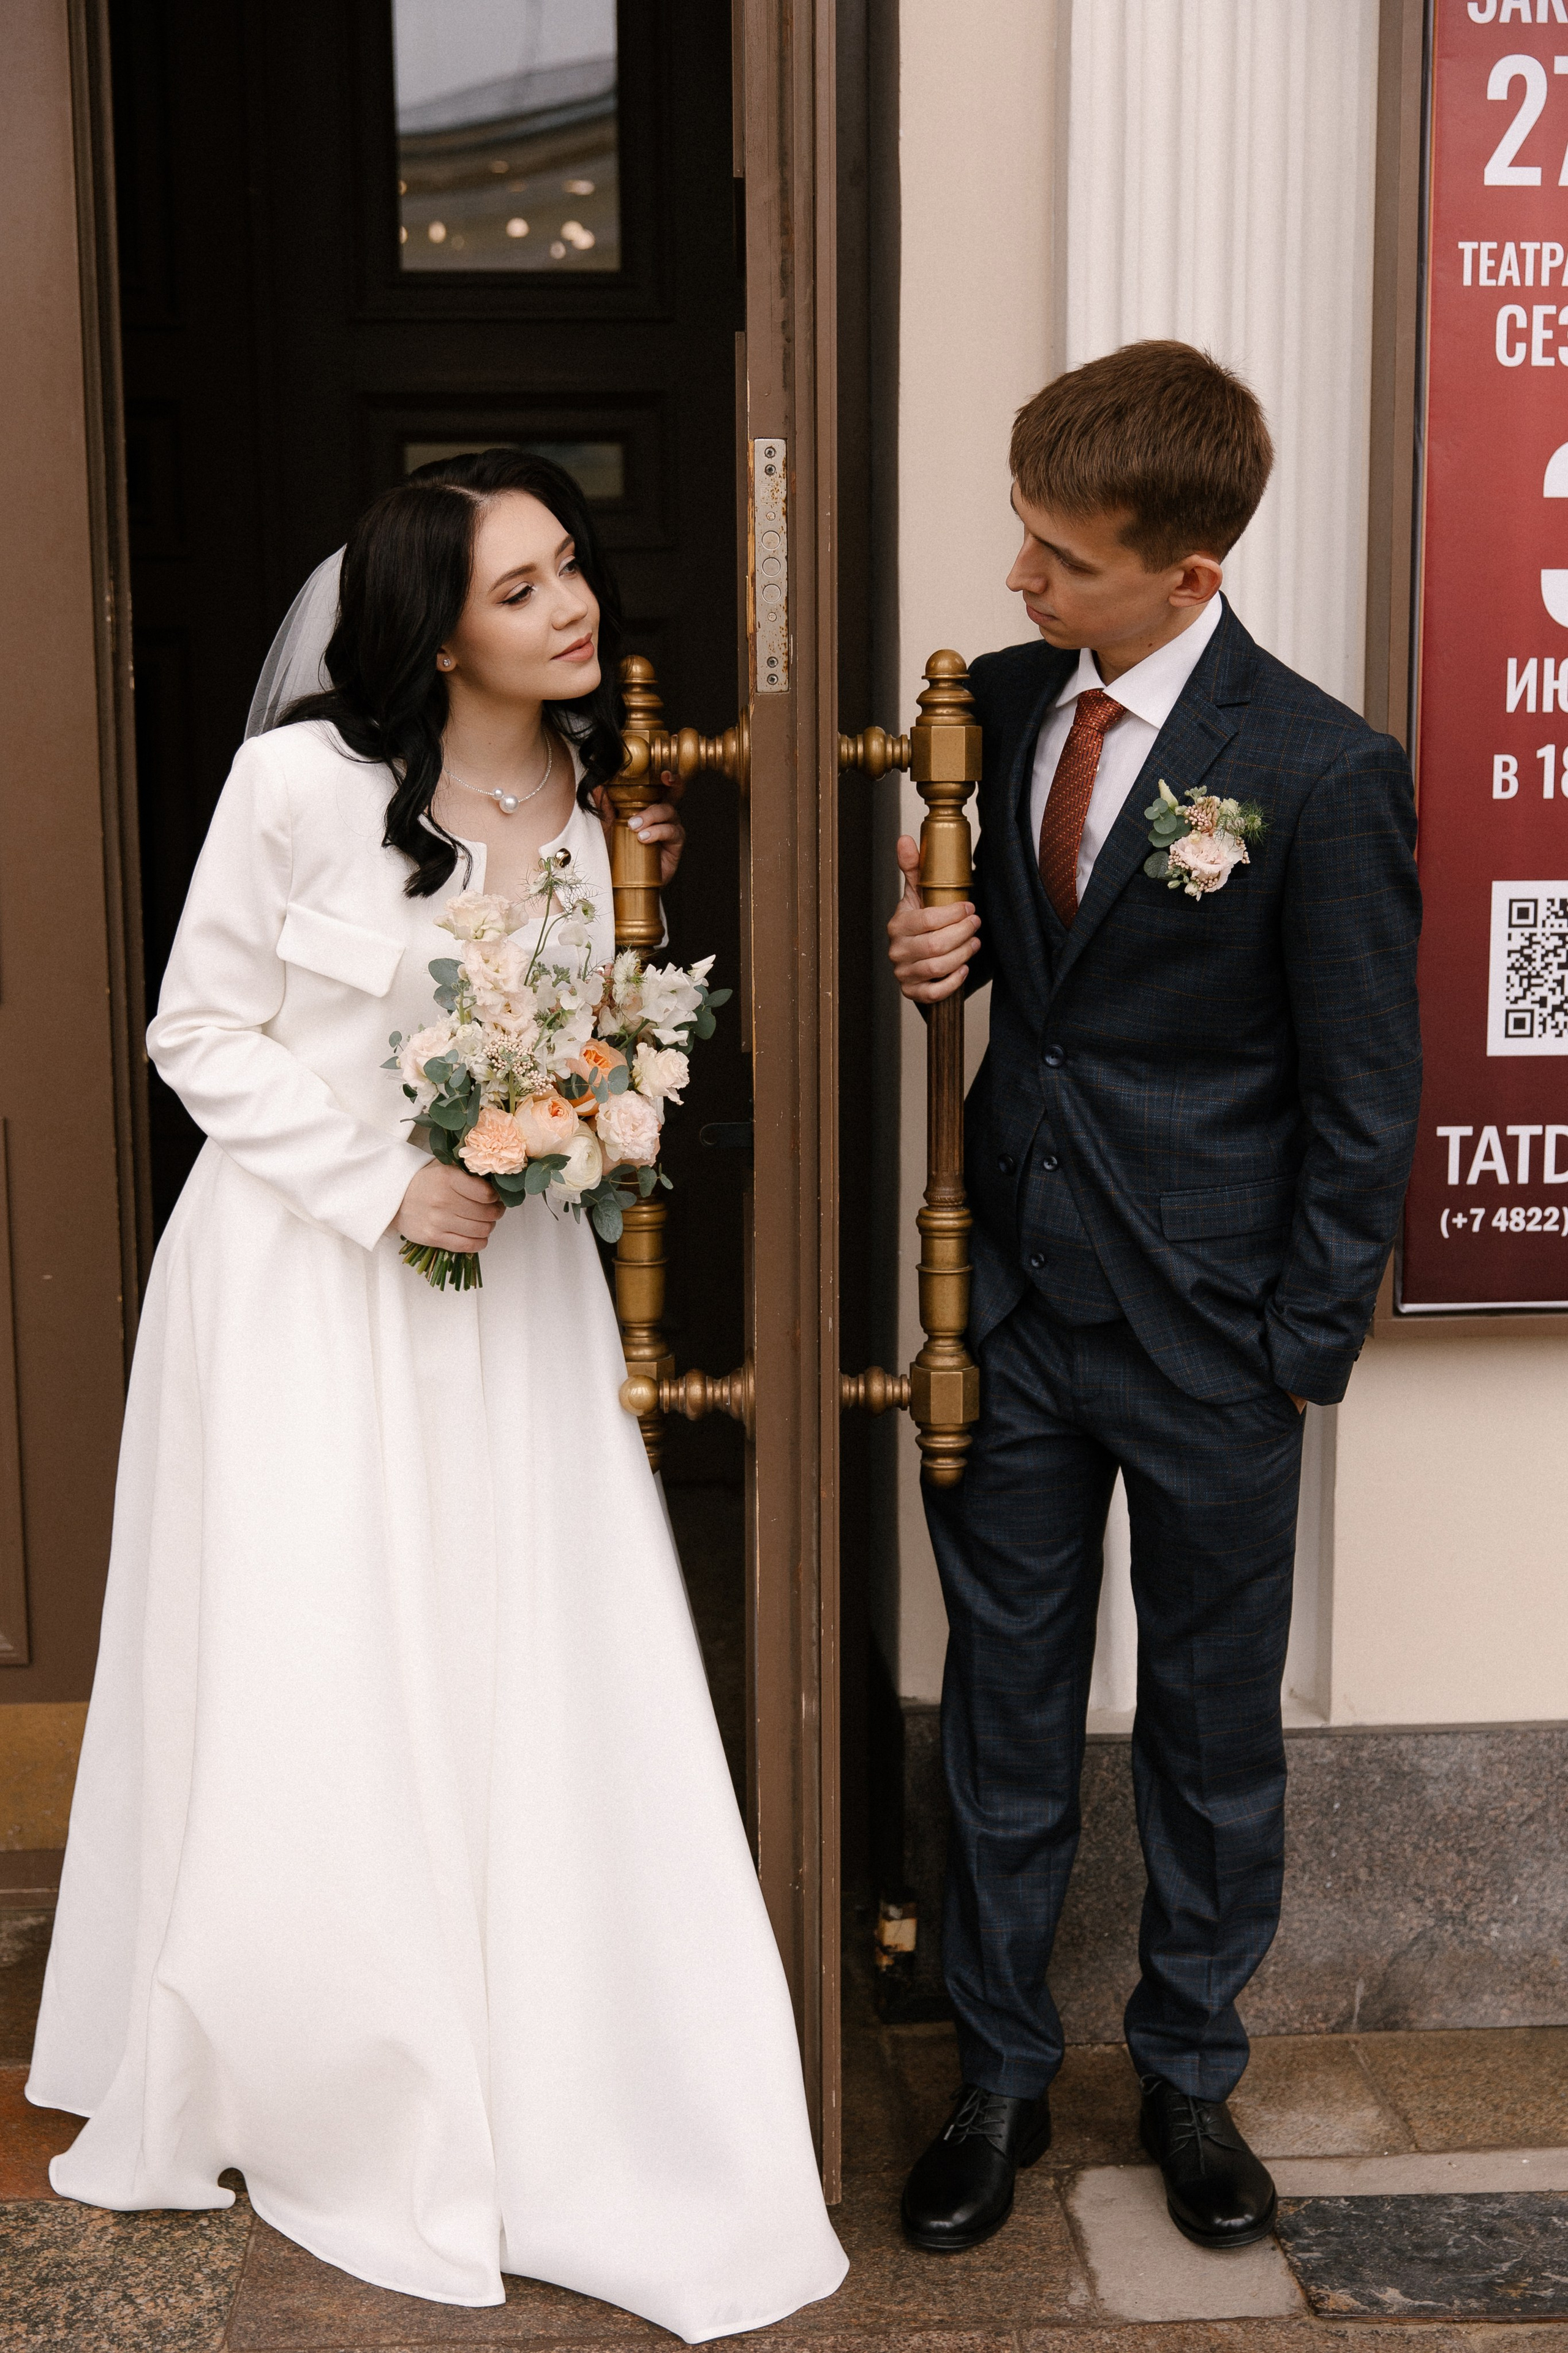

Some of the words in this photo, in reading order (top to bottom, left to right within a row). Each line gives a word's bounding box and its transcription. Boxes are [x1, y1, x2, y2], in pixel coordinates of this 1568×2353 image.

[1483, 53, 1568, 186] 2
[1457, 241, 1568, 287] ТЕАТР
[1536, 743, 1568, 799] 1
[1440, 1207, 1486, 1239] (+7
